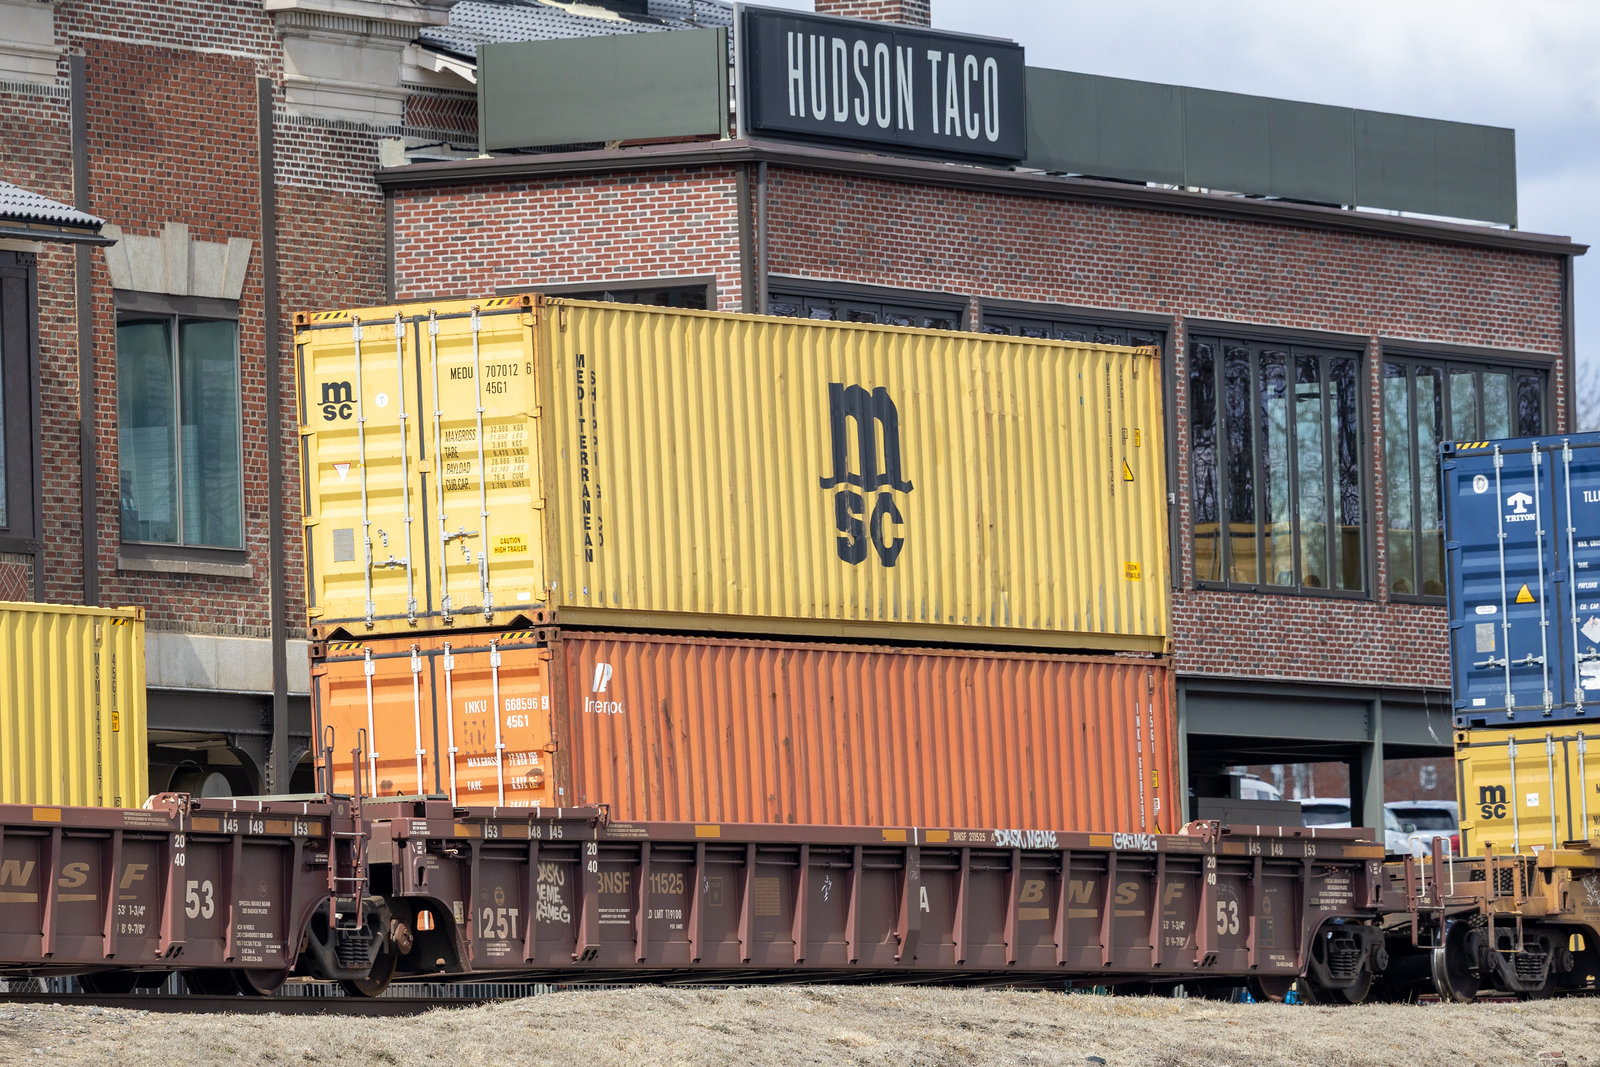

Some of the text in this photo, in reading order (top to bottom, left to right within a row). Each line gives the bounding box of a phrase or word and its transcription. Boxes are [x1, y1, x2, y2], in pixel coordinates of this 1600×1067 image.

[787, 31, 1000, 142] HUDSON TACO
[450, 361, 532, 380] MEDU 707012 6
[485, 381, 508, 394] 45G1
[513, 423, 524, 431] KGS
[444, 446, 459, 459] TARE
[512, 439, 523, 447] KGS
[512, 448, 524, 456] LBS
[446, 461, 471, 475] PAYLOAD
[514, 455, 525, 464] KGS
[575, 353, 594, 563] MEDITERRANEAN
[1505, 513, 1536, 523] TRITON
[500, 536, 521, 545] CAUTION
[465, 700, 487, 714] INKU
[504, 697, 539, 712] 668596
[529, 757, 539, 765] LBS
[467, 781, 482, 791] TARE
[227, 819, 309, 836] 45 48 53
[487, 825, 563, 839] 53 48 45
[174, 834, 186, 848] 20
[953, 831, 967, 841] BNSF
[587, 843, 597, 856] 20
[1251, 842, 1316, 856] 45 48 53
[174, 853, 186, 867] 40
[587, 860, 598, 873] 40
[1206, 856, 1216, 869] 20
[648, 873, 684, 895] 11525
[1206, 873, 1217, 885] 40
[185, 880, 215, 919] 53
[920, 886, 930, 913] A
[1217, 900, 1240, 936] 53
